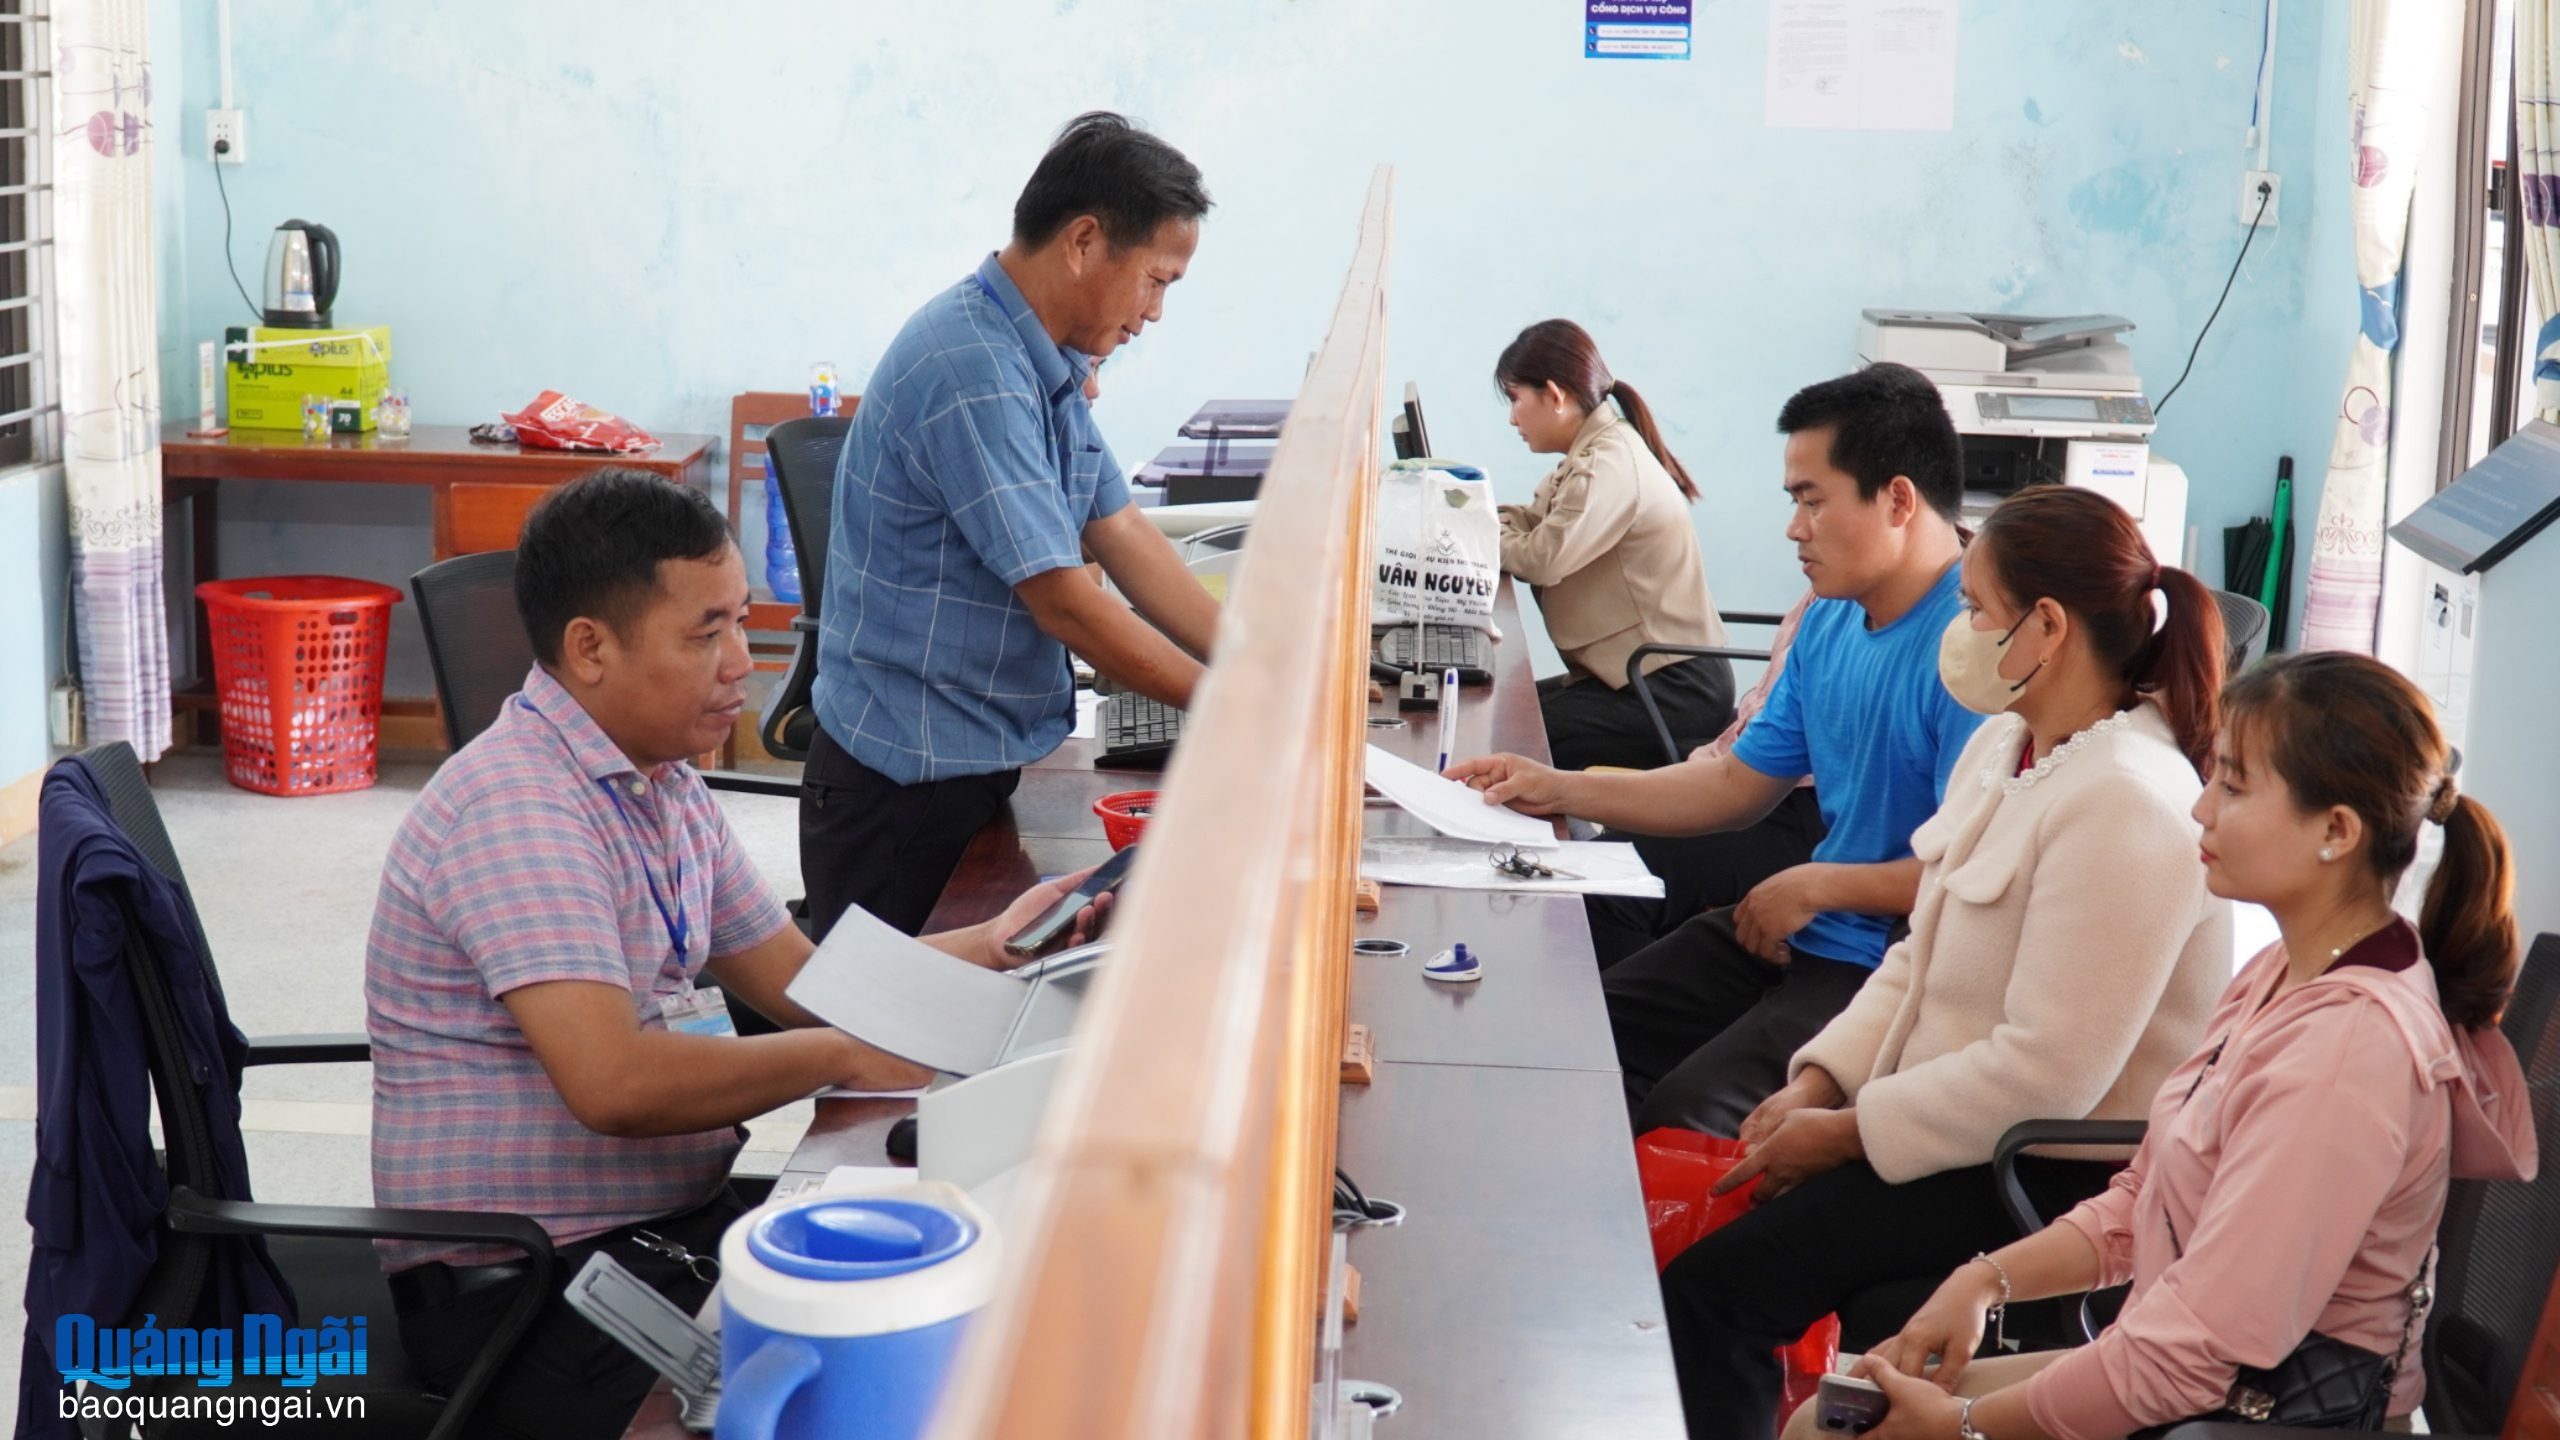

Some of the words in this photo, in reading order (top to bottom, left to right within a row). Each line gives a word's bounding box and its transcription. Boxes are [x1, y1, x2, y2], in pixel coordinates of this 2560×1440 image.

[1591, 1, 1619, 13] CỔNG
[1620, 5, 1644, 16] DỊCH
[1645, 6, 1658, 16] VỤ
[1659, 4, 1687, 15] CÔNG
[340, 387, 353, 396] A4
[338, 413, 352, 423] 70
[1379, 562, 1418, 588] VÂN
